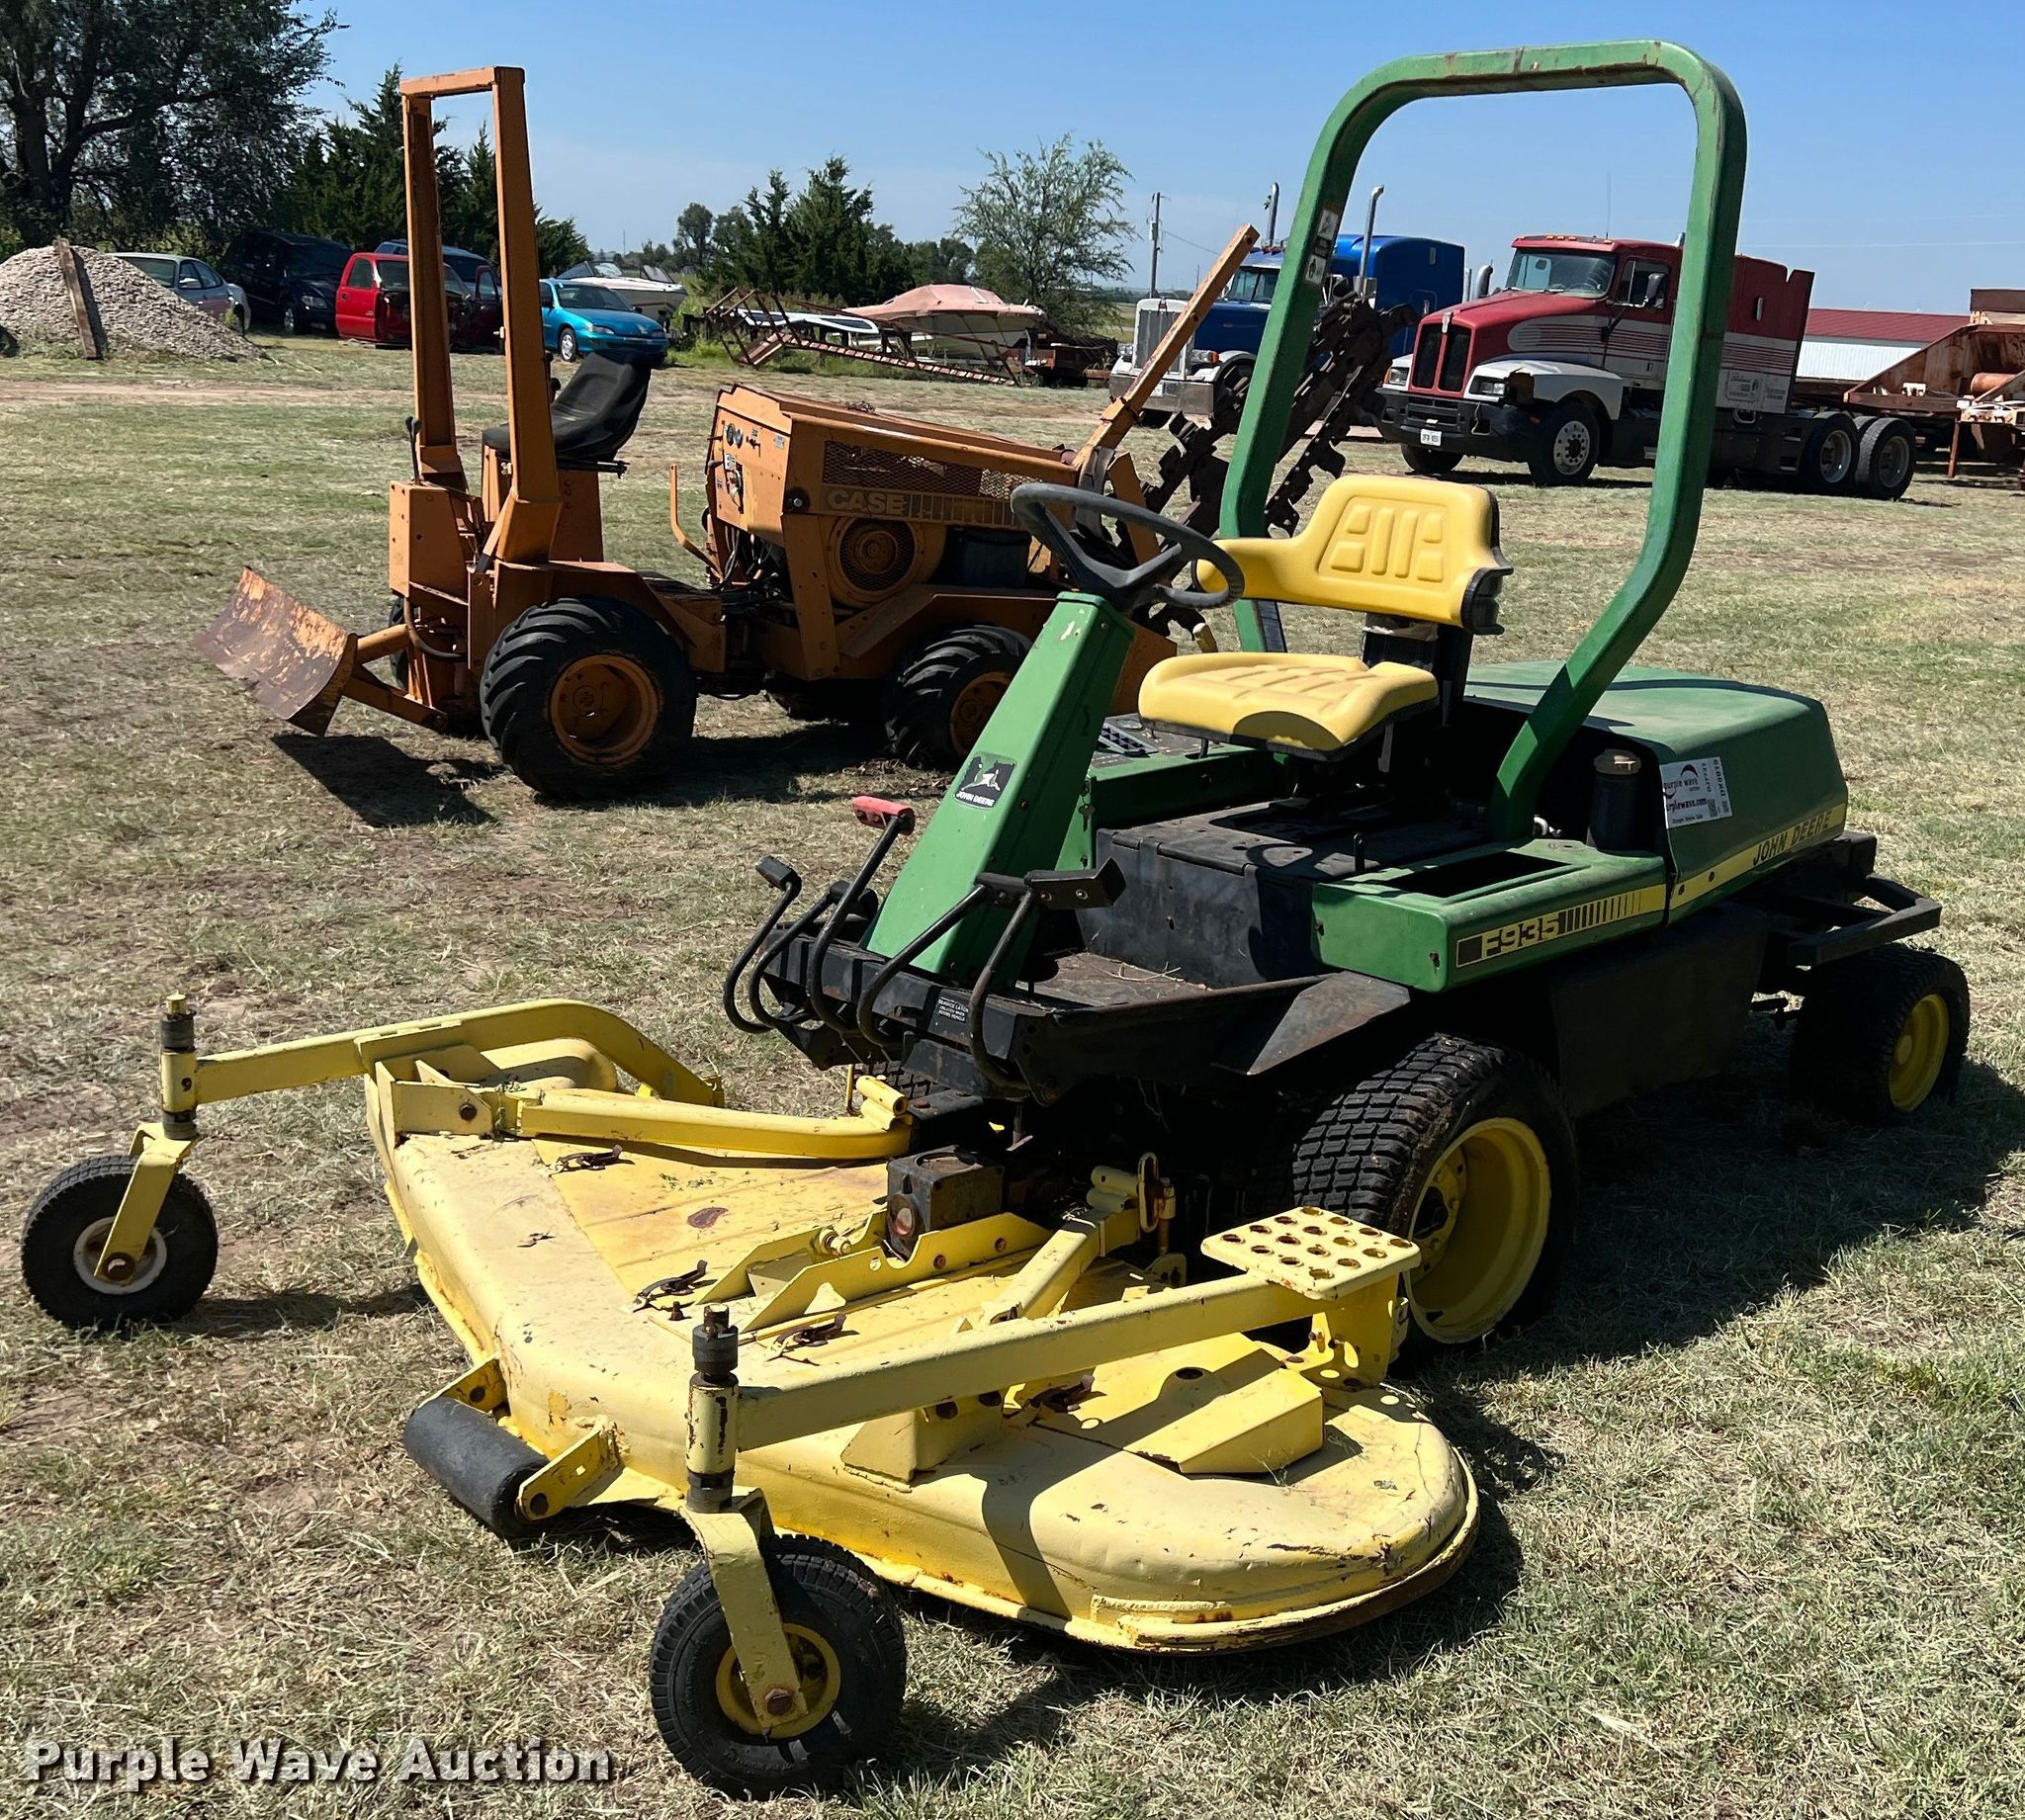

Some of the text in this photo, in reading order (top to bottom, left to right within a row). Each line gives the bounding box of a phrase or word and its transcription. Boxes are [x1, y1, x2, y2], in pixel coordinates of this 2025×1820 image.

[828, 489, 905, 515] CASE
[956, 791, 995, 807] JOHN DEERE
[1666, 798, 1708, 814] urplewave.com
[1753, 811, 1832, 866] JOHN DEERE
[1484, 916, 1560, 959] F935
